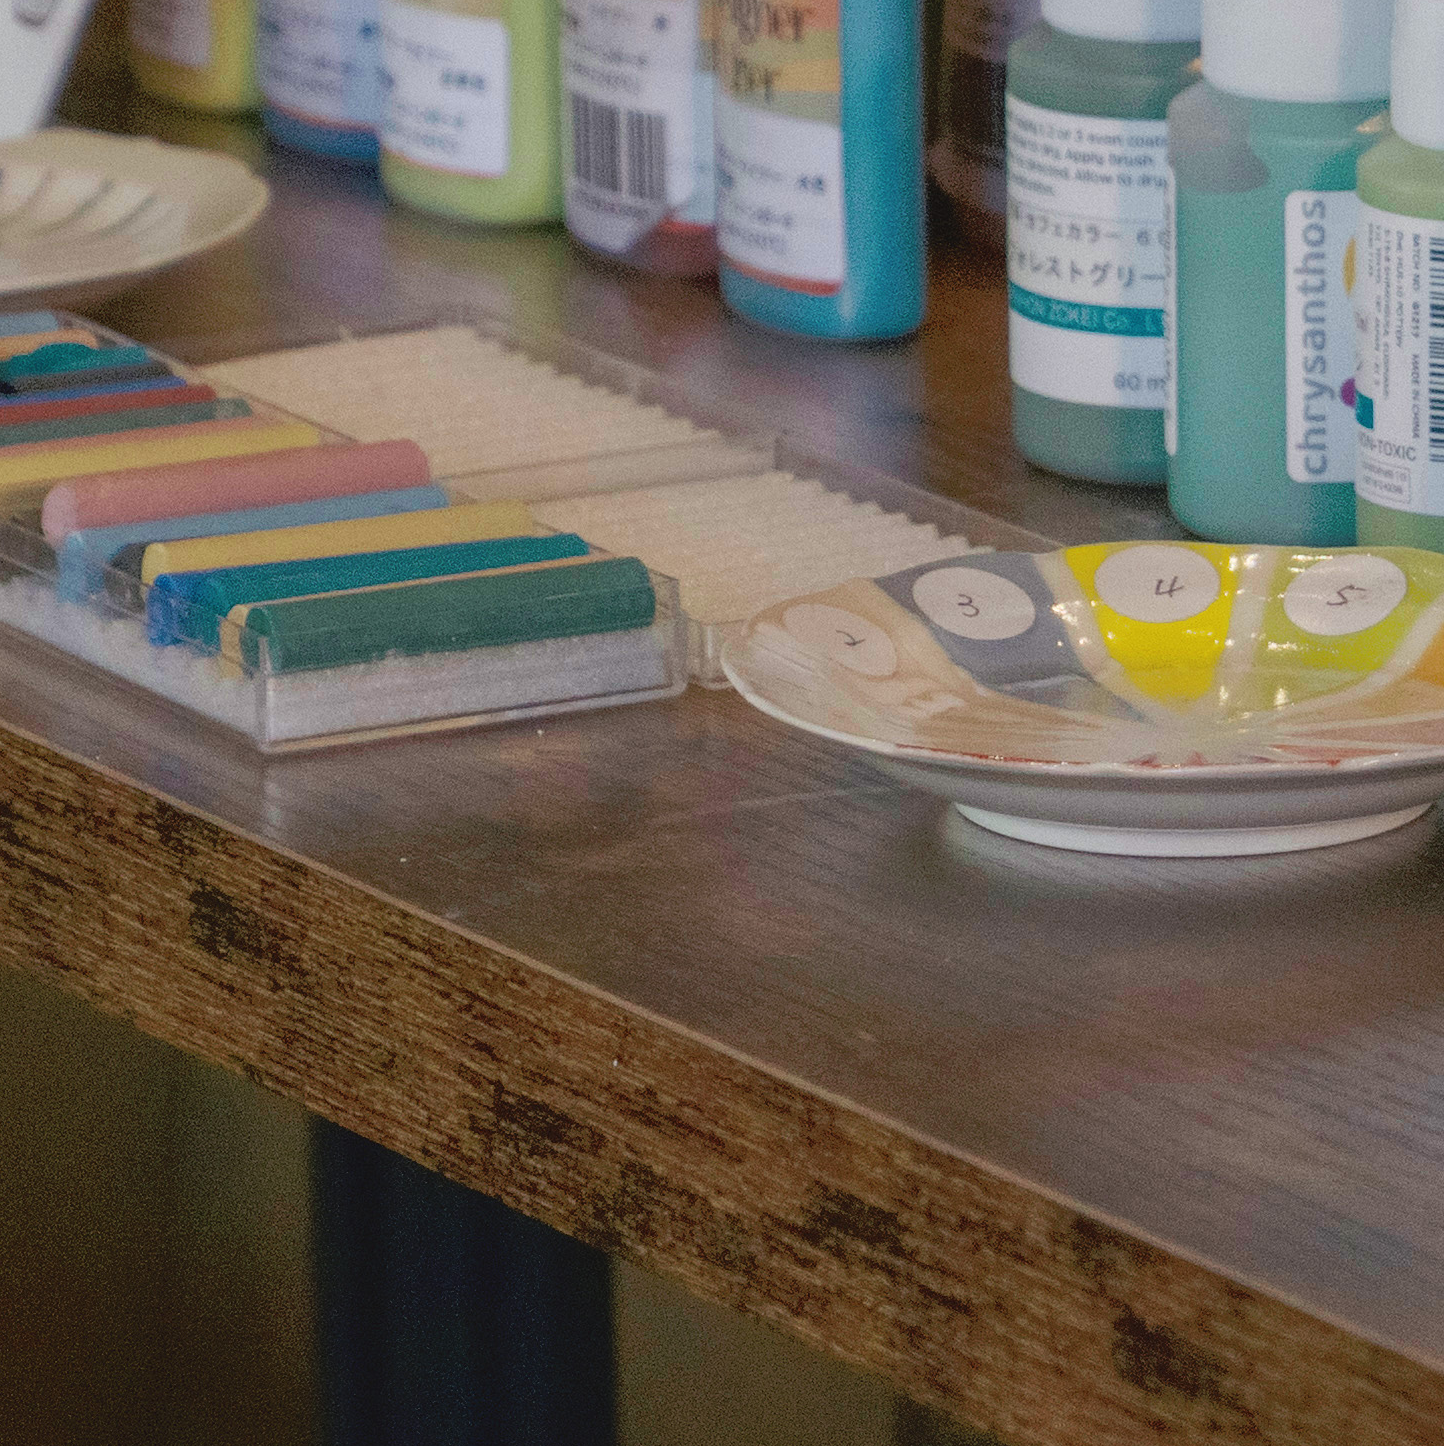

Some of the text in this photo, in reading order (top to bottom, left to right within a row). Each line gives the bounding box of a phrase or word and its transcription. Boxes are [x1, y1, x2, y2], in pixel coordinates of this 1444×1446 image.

[1295, 199, 1334, 476] chrysanthos
[1359, 431, 1416, 462] ON-TOXIC
[1155, 575, 1186, 599] 4
[1326, 583, 1366, 606] 5
[957, 593, 981, 618] 3
